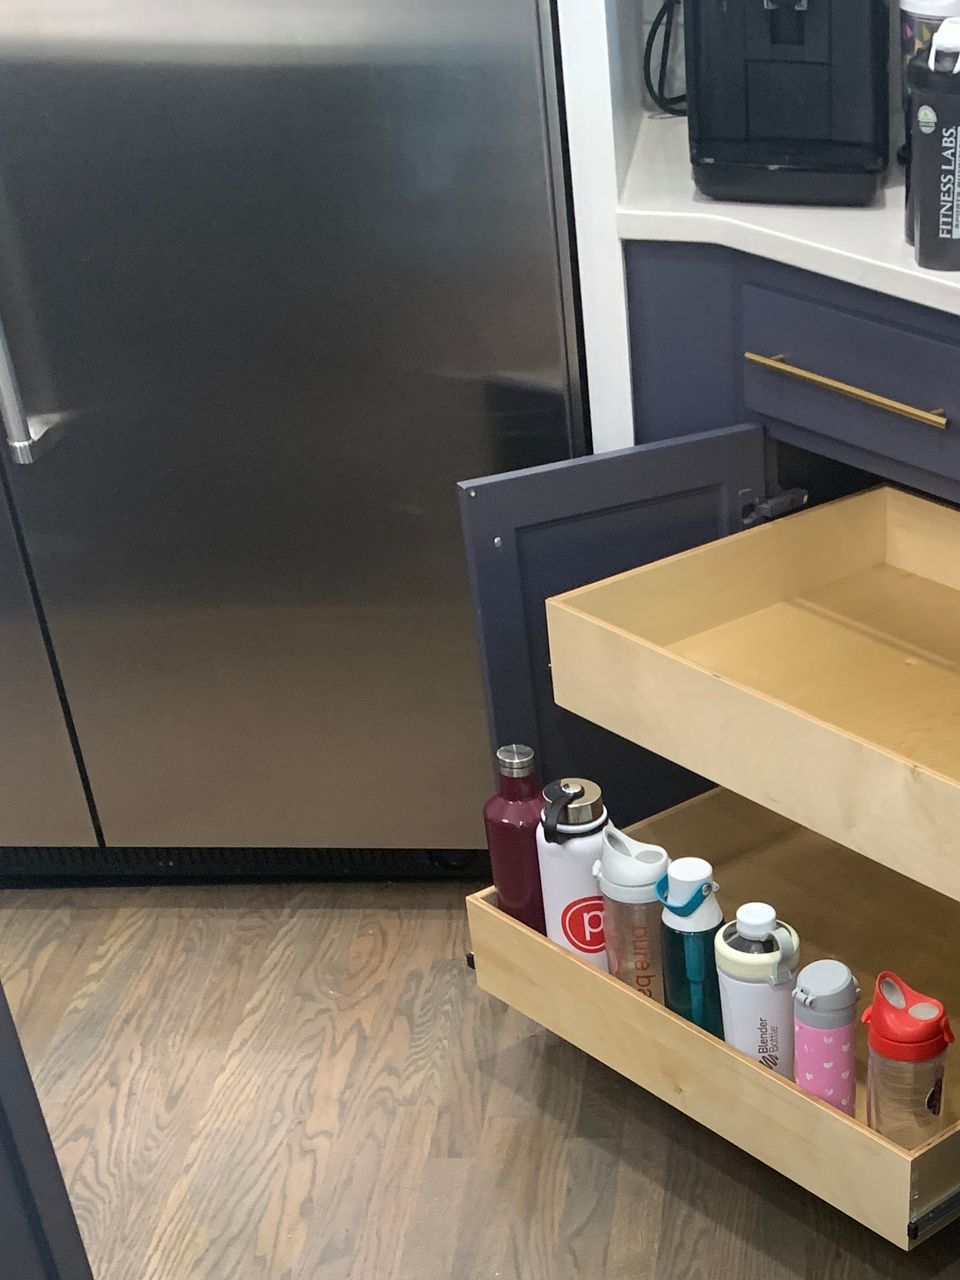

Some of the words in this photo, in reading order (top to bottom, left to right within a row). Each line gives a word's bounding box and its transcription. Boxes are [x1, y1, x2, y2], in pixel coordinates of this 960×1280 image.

[939, 174, 955, 239] FITNESS
[757, 1017, 769, 1054] Blender
[768, 1026, 779, 1053] Bottle
